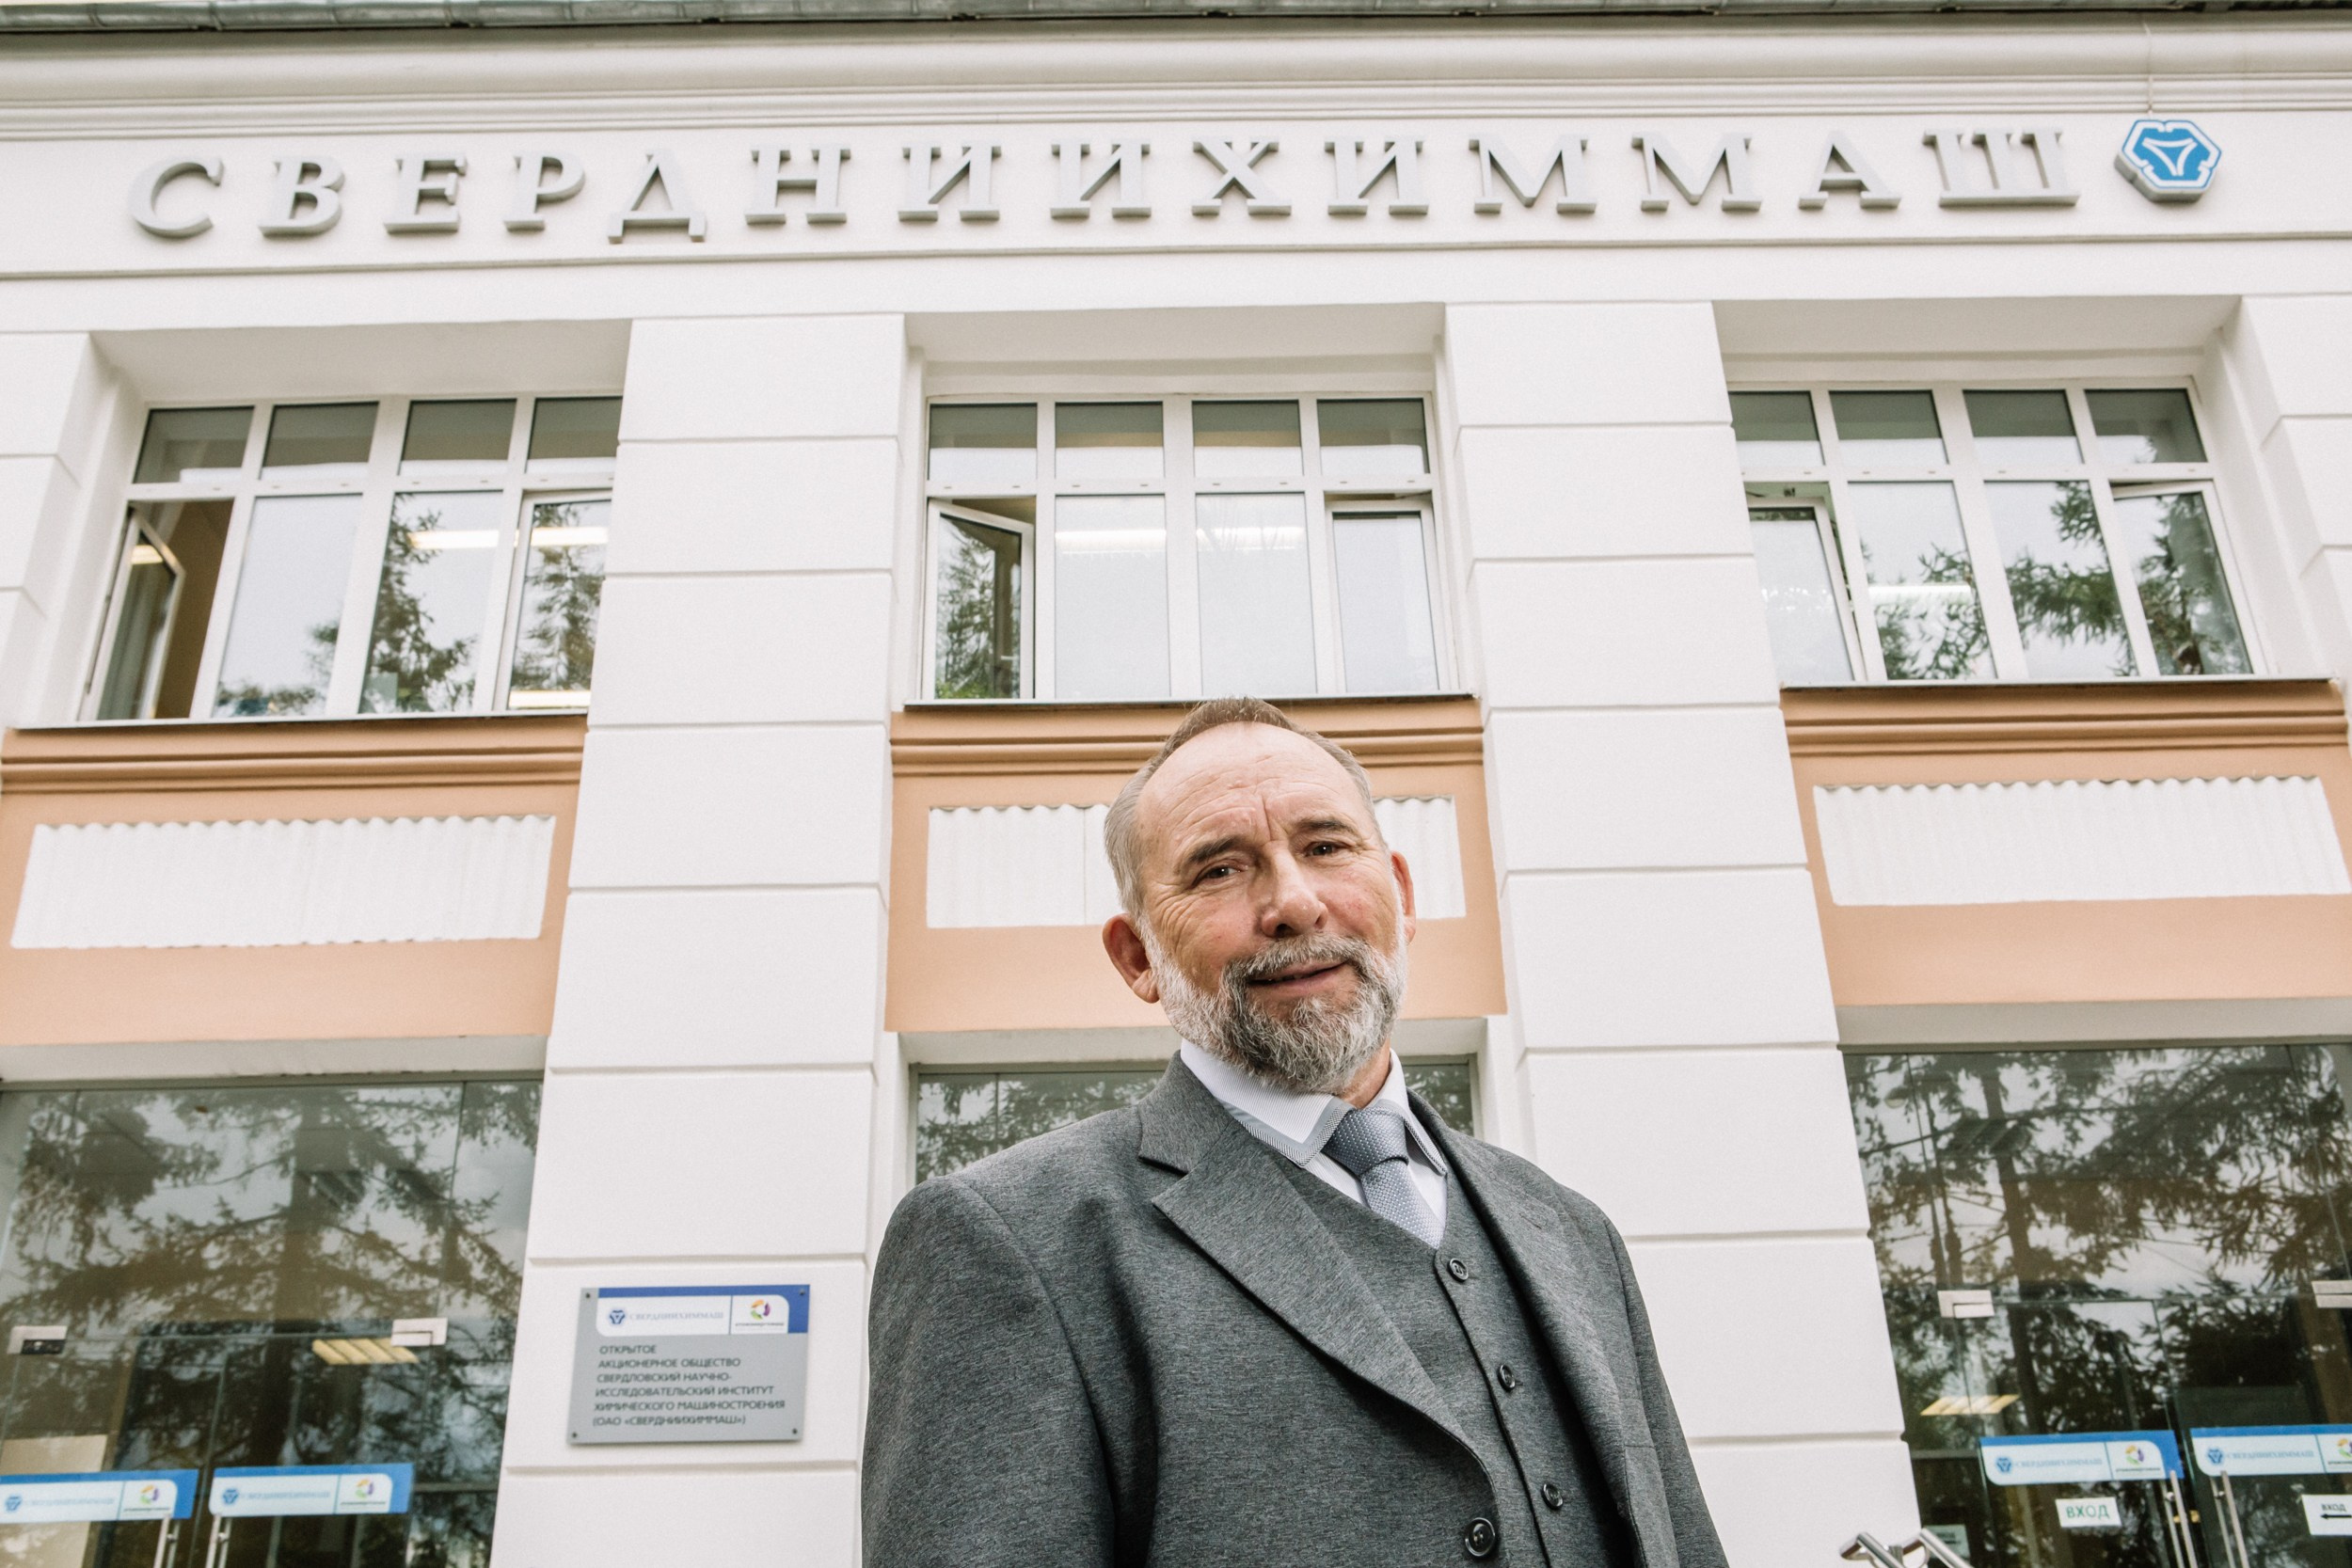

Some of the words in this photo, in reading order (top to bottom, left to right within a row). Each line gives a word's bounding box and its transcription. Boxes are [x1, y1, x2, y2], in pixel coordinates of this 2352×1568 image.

[128, 126, 2081, 244] СВЕРДНИИХИММАШ
[599, 1344, 657, 1354] ОТКРЫТОЕ
[597, 1358, 678, 1370] АКЦИОНЕРНОЕ
[680, 1357, 741, 1369] ОБЩЕСТВО
[596, 1371, 681, 1384] СВЕРДЛОВСКИЙ
[683, 1371, 733, 1382] НАУЧНО-
[595, 1386, 716, 1399] ИССЛЕДОВАТЕЛЬСКИЙ
[718, 1385, 774, 1396] ИНСТИТУТ
[594, 1401, 675, 1412] ХИМИЧЕСКОГО
[676, 1400, 786, 1411] МАШИНОСТРОЕНИЯ
[593, 1416, 622, 1427] (ОАО
[2066, 1504, 2110, 1520] ВХОД
[2320, 1503, 2347, 1513] ВХОД
